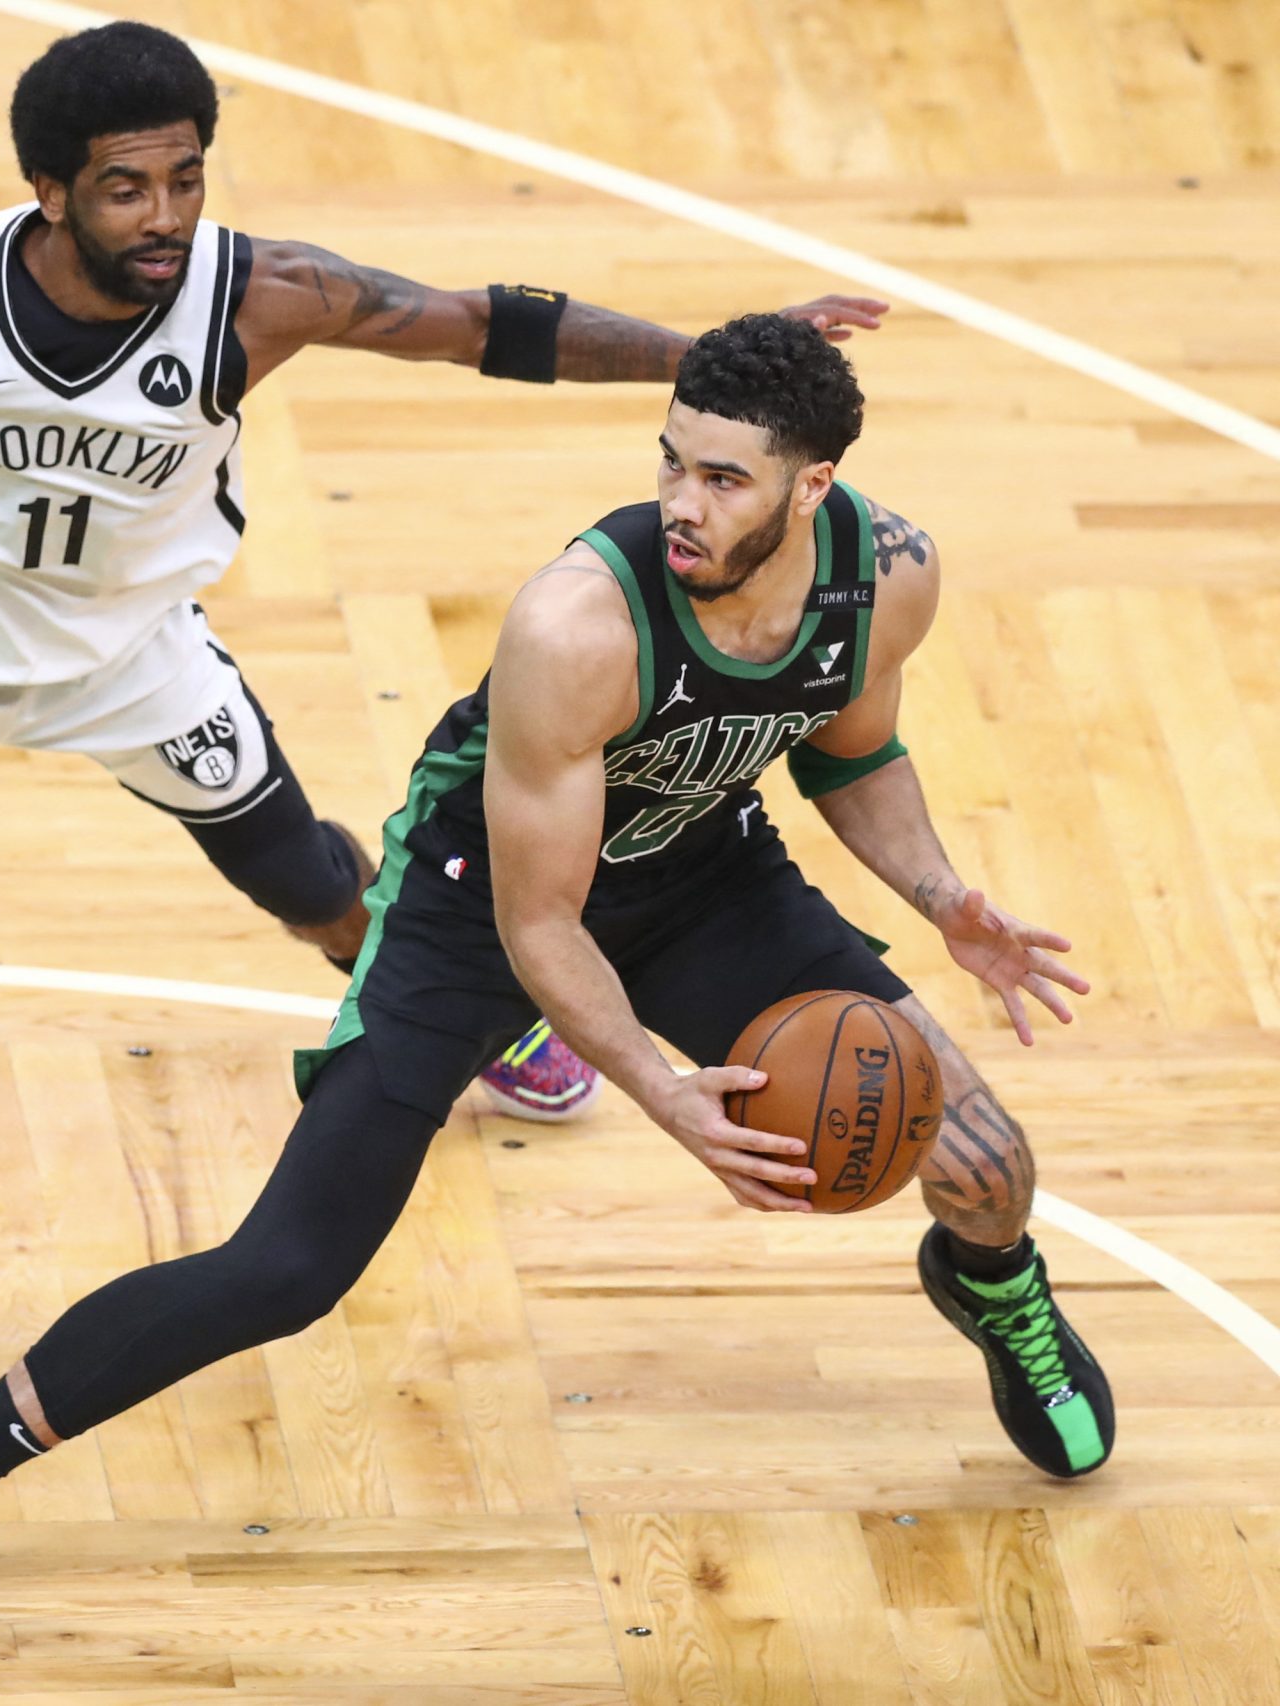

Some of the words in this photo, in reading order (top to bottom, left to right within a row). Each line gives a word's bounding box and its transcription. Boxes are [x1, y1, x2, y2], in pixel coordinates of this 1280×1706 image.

[19, 496, 92, 570] 11
[818, 591, 849, 605] TOMMY
[853, 589, 870, 601] K.C.
[803, 673, 847, 689] vistaprint
[163, 708, 236, 767] NETS
[205, 755, 225, 781] B
[831, 1047, 891, 1195] SPALDING
